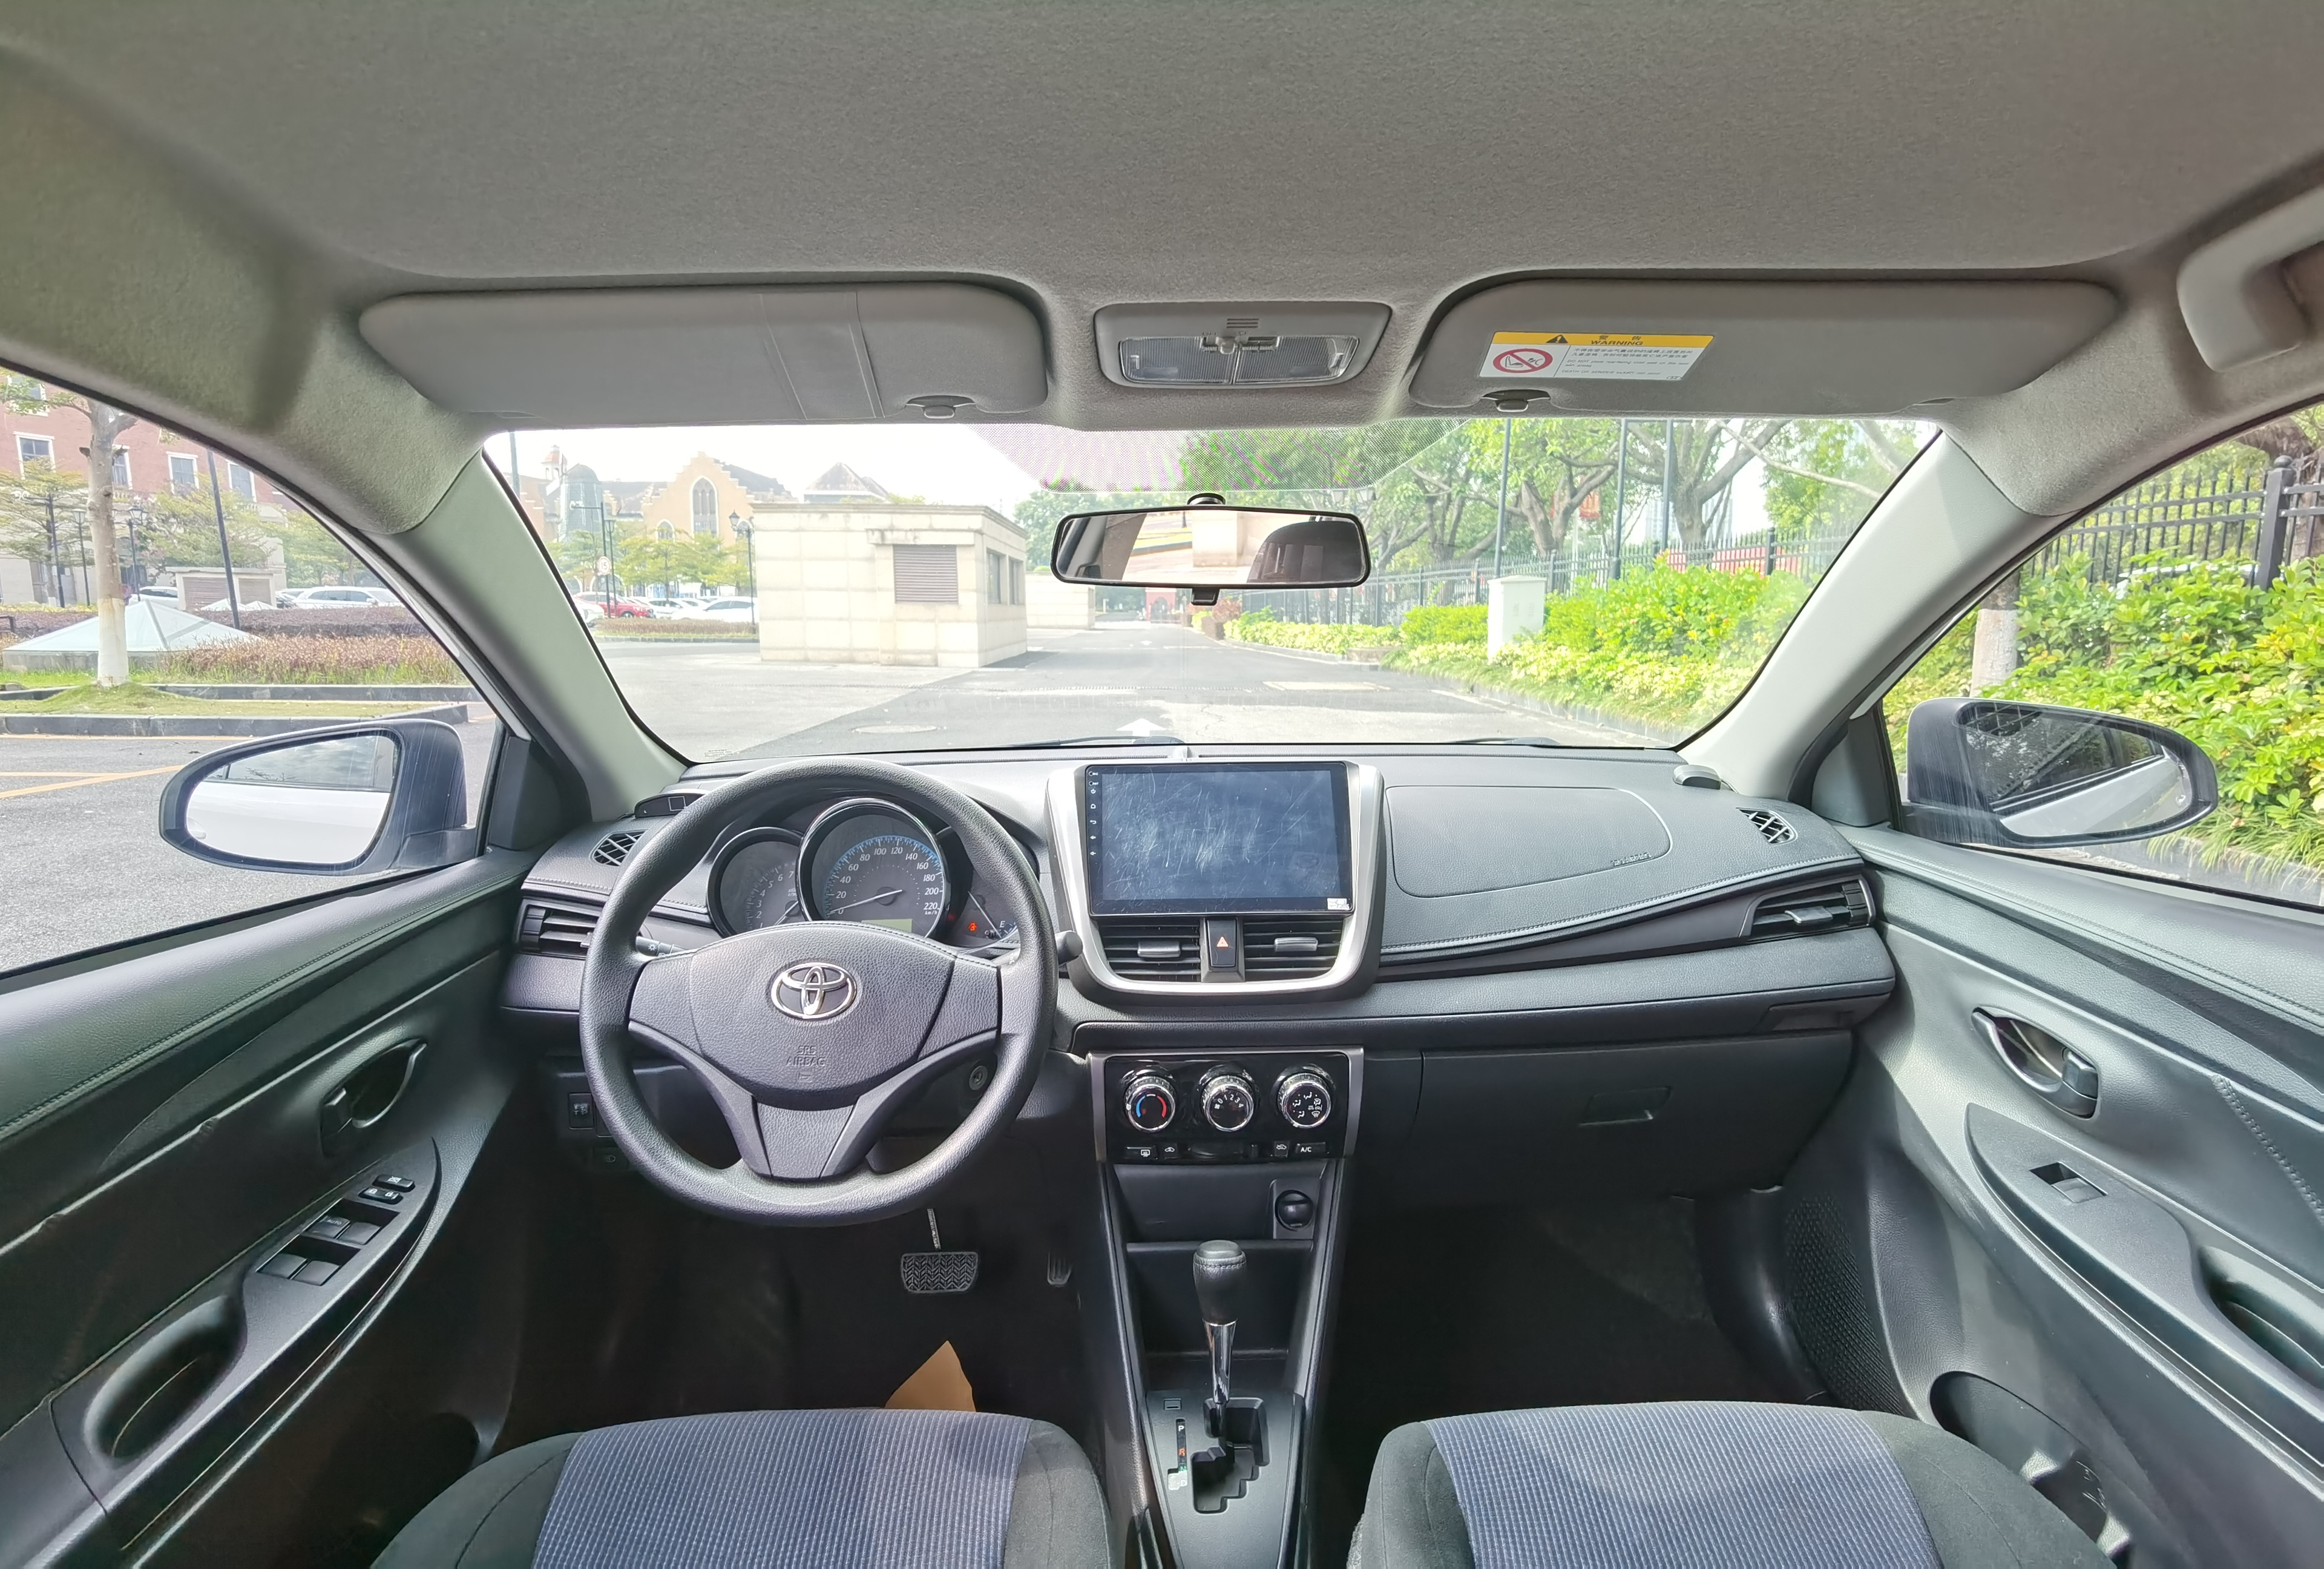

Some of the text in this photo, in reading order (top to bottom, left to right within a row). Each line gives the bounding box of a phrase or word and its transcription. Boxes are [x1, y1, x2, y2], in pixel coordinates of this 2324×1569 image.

[601, 562, 608, 570] 15
[836, 890, 847, 899] 20
[924, 887, 939, 895] 200
[797, 1045, 816, 1054] SRS
[786, 1056, 826, 1067] AIRBAG
[1179, 1448, 1186, 1456] R
